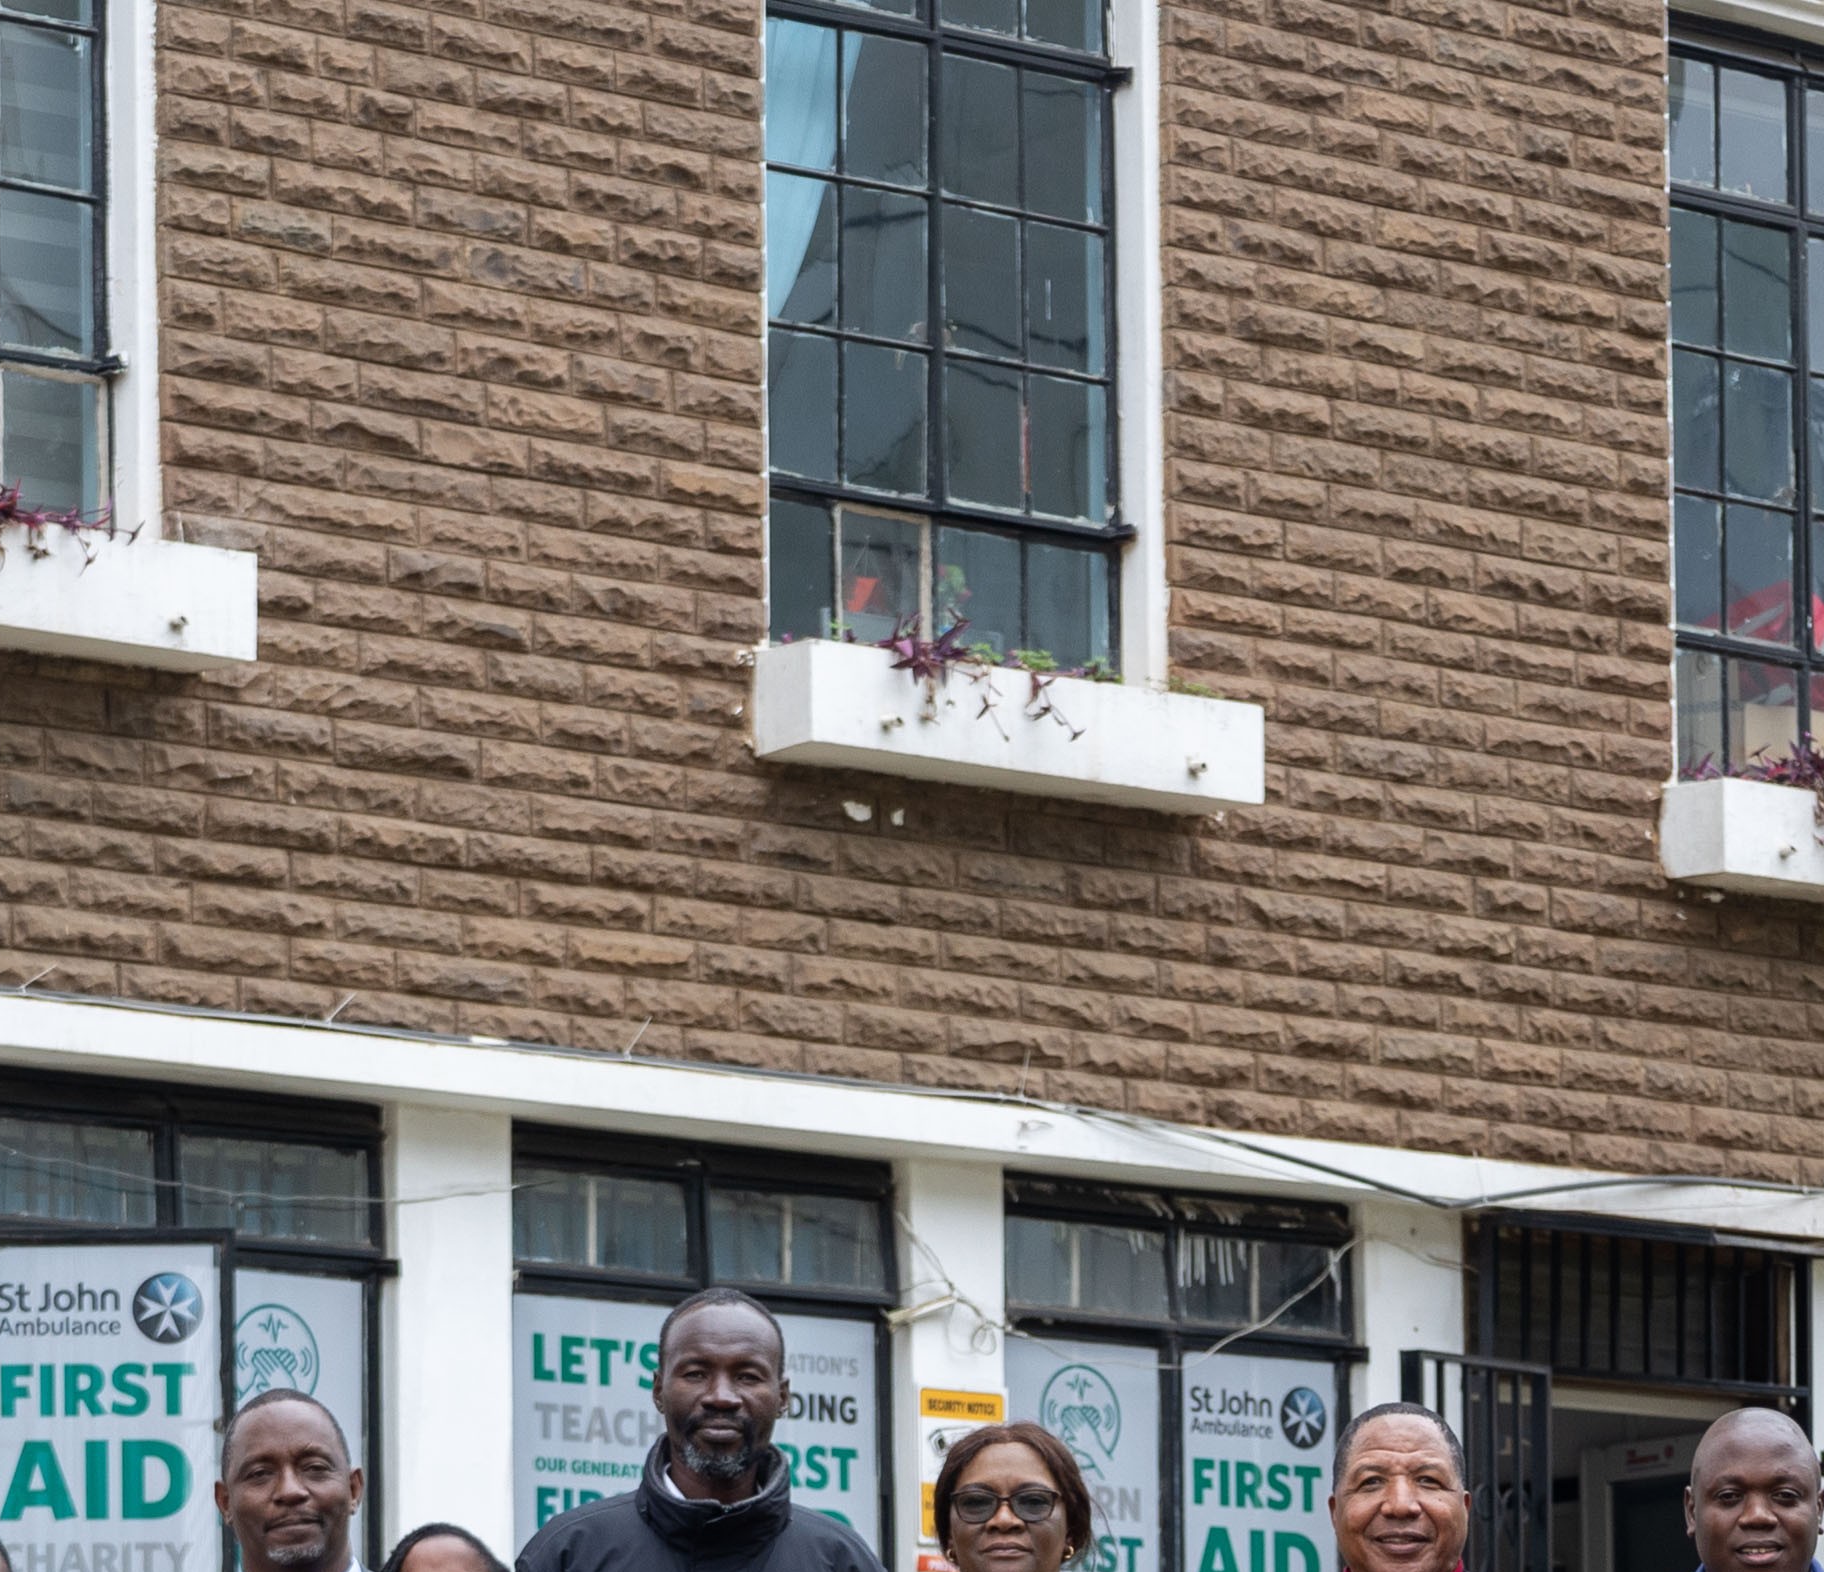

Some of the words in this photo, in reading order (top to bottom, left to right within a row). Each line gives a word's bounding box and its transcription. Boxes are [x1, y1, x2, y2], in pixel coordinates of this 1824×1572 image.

[37, 1282, 121, 1313] John
[533, 1332, 660, 1390] LET'S
[786, 1353, 860, 1377] ATION'S
[0, 1362, 197, 1418] FIRST
[1190, 1386, 1213, 1414] St
[1218, 1388, 1273, 1418] John
[534, 1401, 663, 1448] TEACH
[788, 1392, 859, 1425] DING
[1191, 1417, 1274, 1439] Ambulance
[0, 1439, 194, 1521] AID
[535, 1456, 567, 1473] OUR
[571, 1459, 644, 1480] GENERAT
[1193, 1457, 1322, 1513] FIRST
